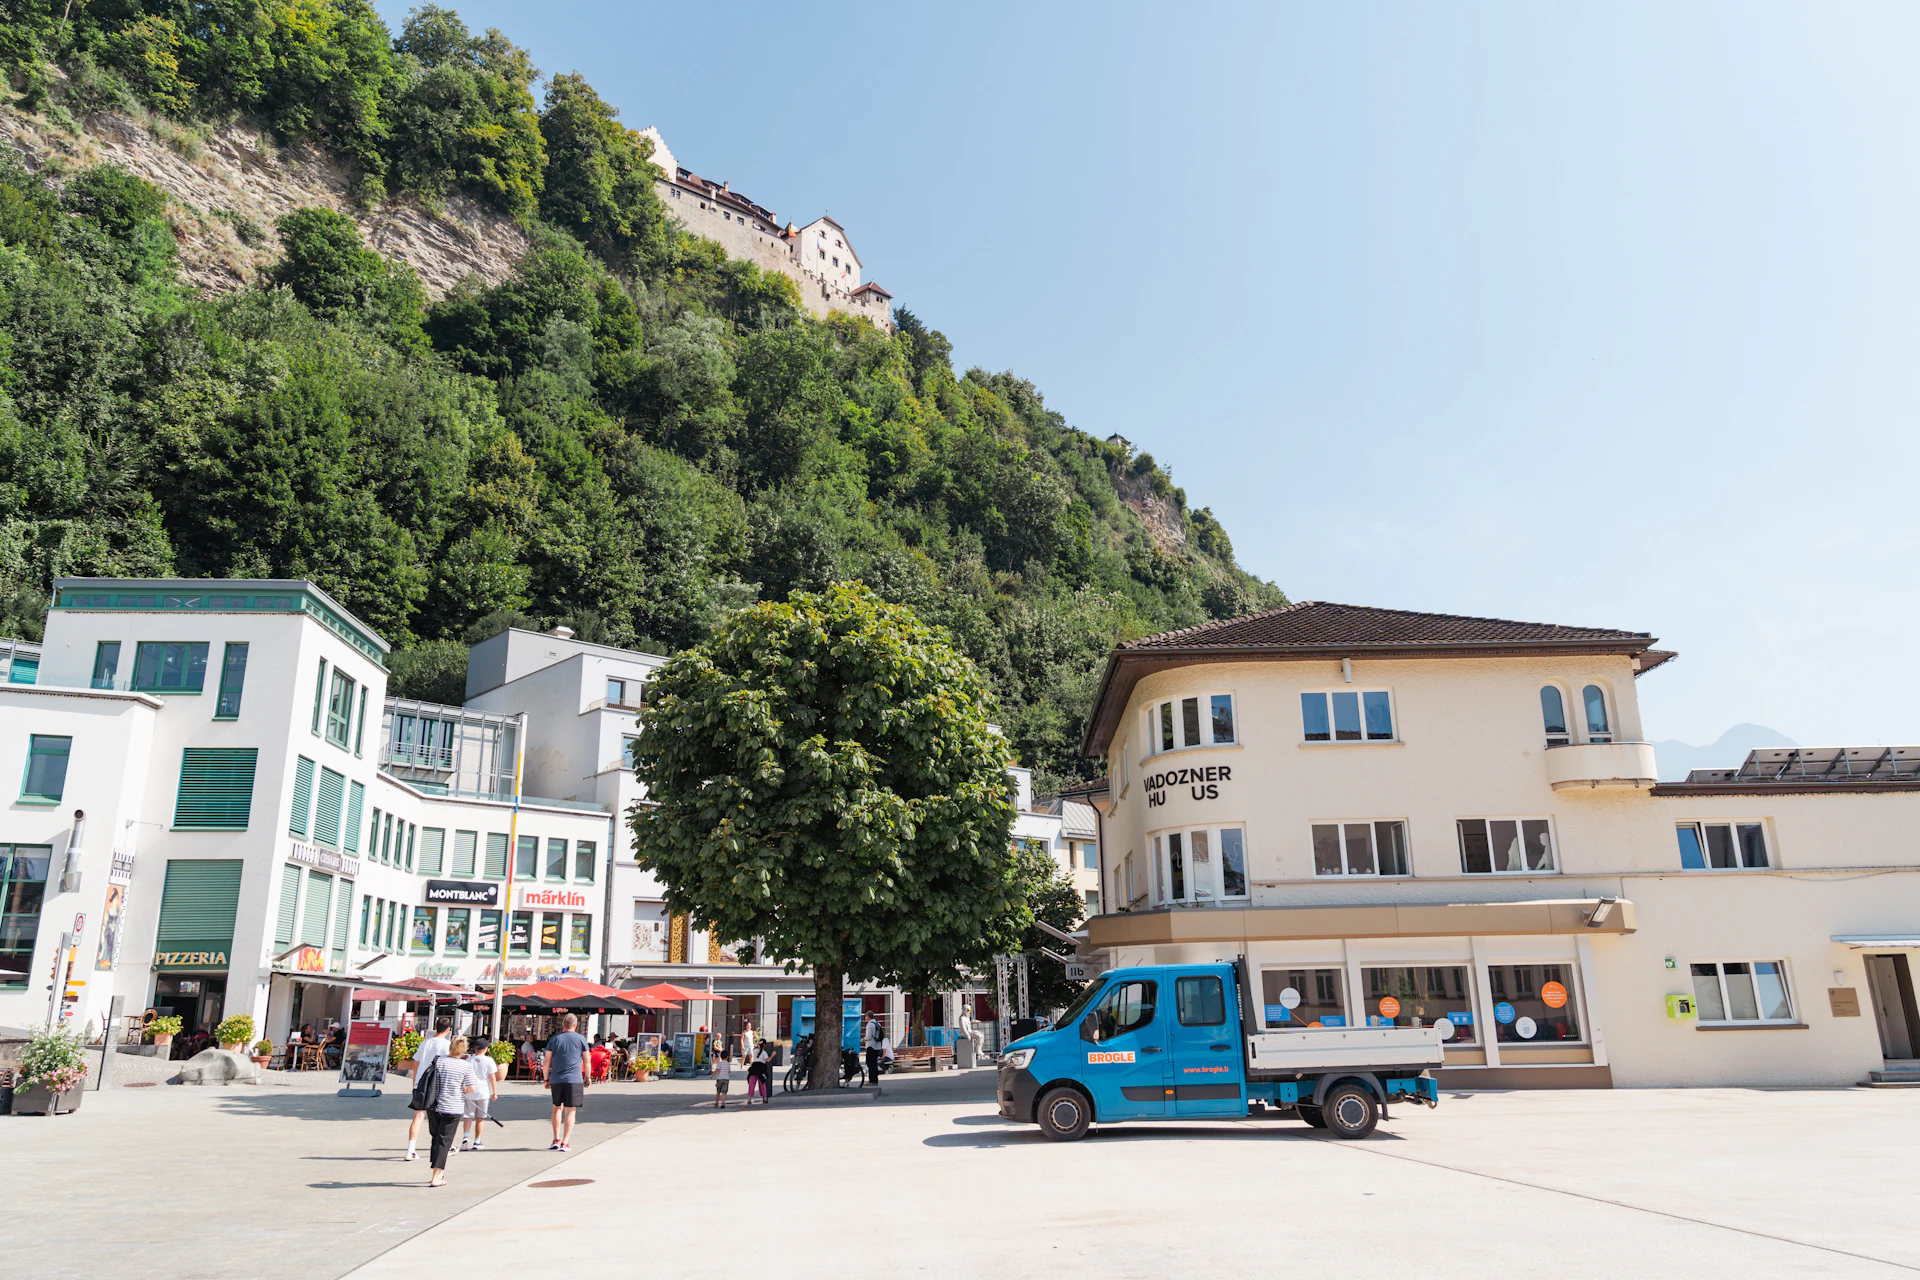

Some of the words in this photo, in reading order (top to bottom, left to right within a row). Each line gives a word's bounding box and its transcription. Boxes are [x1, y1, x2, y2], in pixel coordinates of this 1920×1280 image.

[1143, 765, 1232, 793] VADOZNER
[1148, 789, 1166, 808] HU
[1191, 784, 1219, 801] US
[429, 889, 488, 901] MONTBLANC
[154, 952, 227, 965] PIZZERIA
[419, 962, 459, 976] thöny
[480, 964, 533, 976] Mkado
[1089, 1053, 1135, 1063] BROGLE
[1183, 1066, 1229, 1074] www.brogle.li
